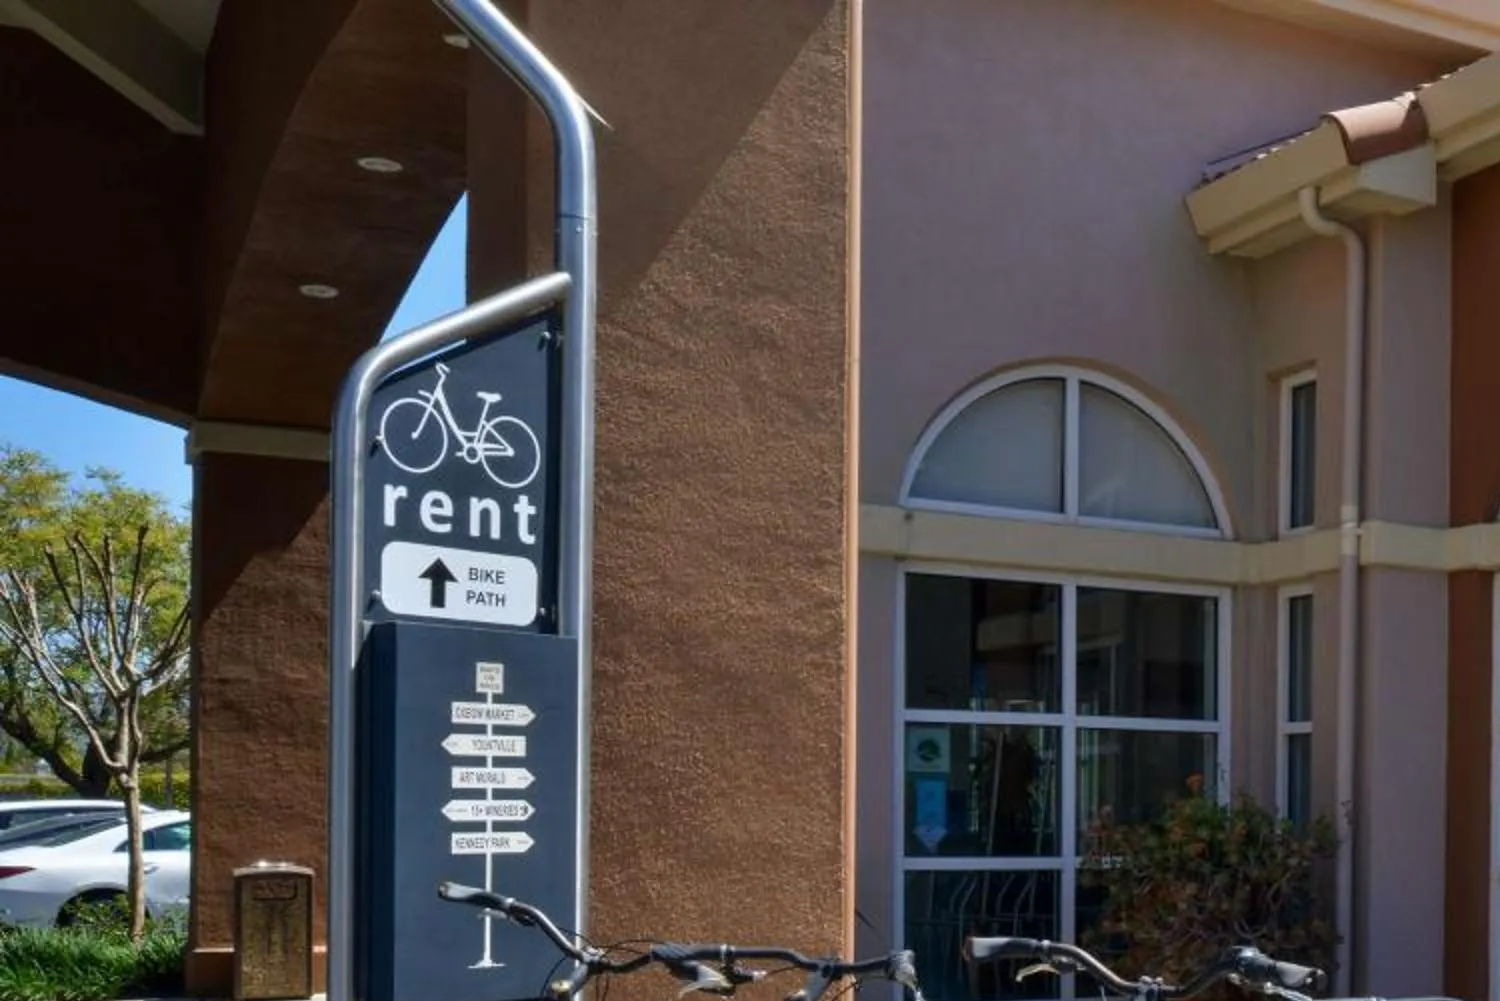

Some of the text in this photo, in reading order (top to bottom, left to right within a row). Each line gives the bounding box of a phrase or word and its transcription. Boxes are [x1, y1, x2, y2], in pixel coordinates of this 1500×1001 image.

[383, 483, 538, 545] rent
[468, 567, 506, 585] BIKE
[466, 590, 506, 608] PATH
